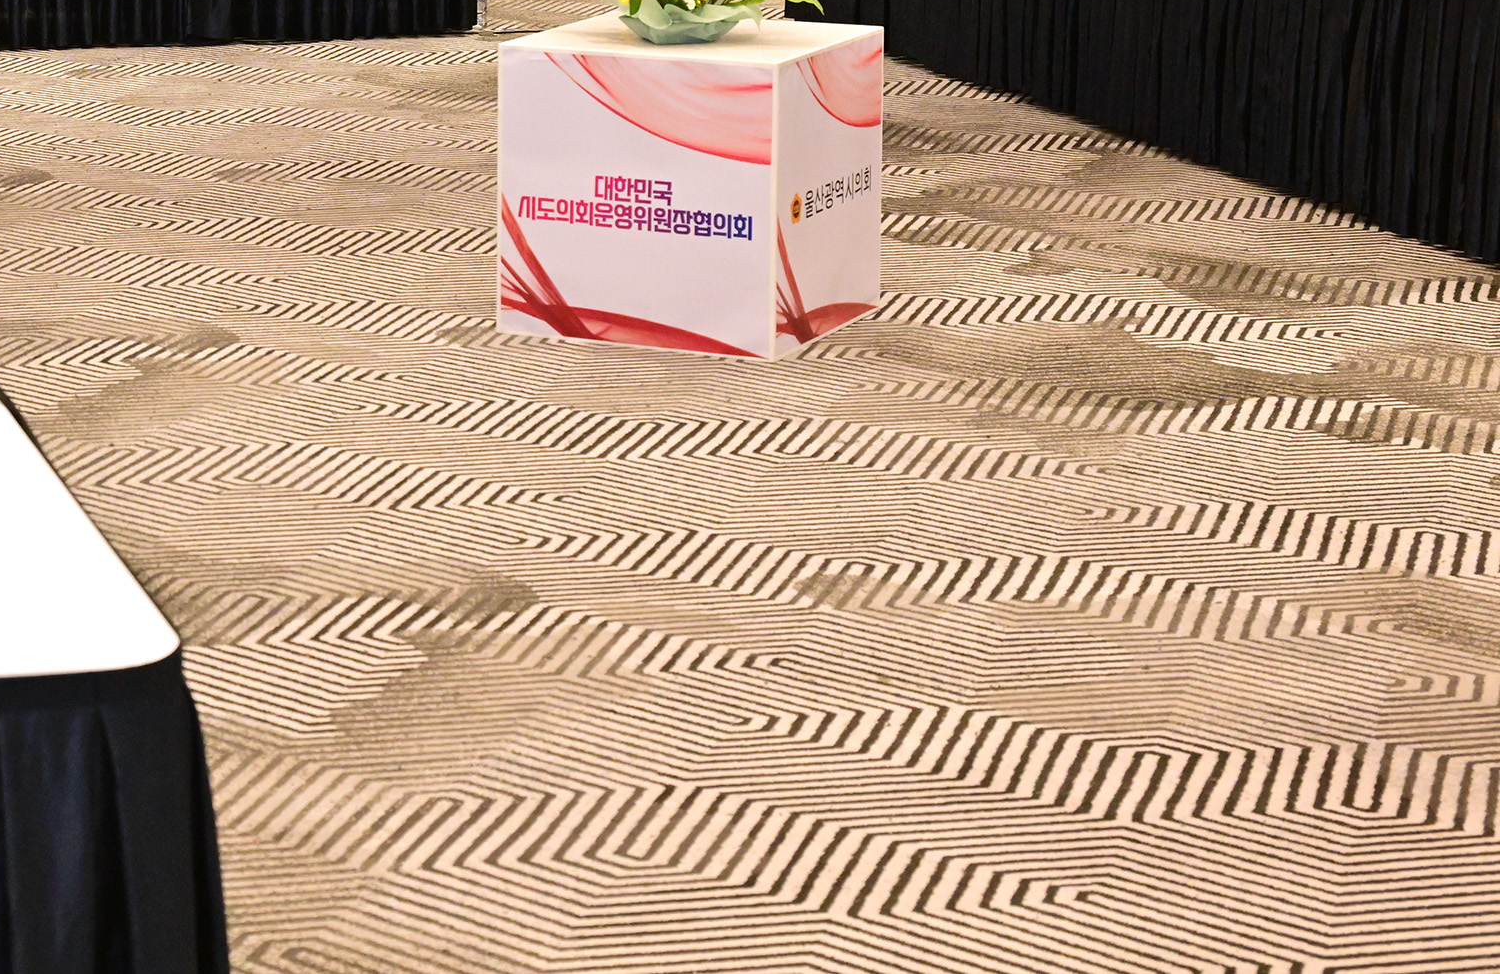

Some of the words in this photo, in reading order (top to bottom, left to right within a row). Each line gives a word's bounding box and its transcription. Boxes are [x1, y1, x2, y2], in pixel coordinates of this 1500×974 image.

[594, 175, 673, 206] 대한민국
[803, 167, 872, 219] 울산광역시의회
[518, 195, 753, 241] 시도의회운영위원장협의회
